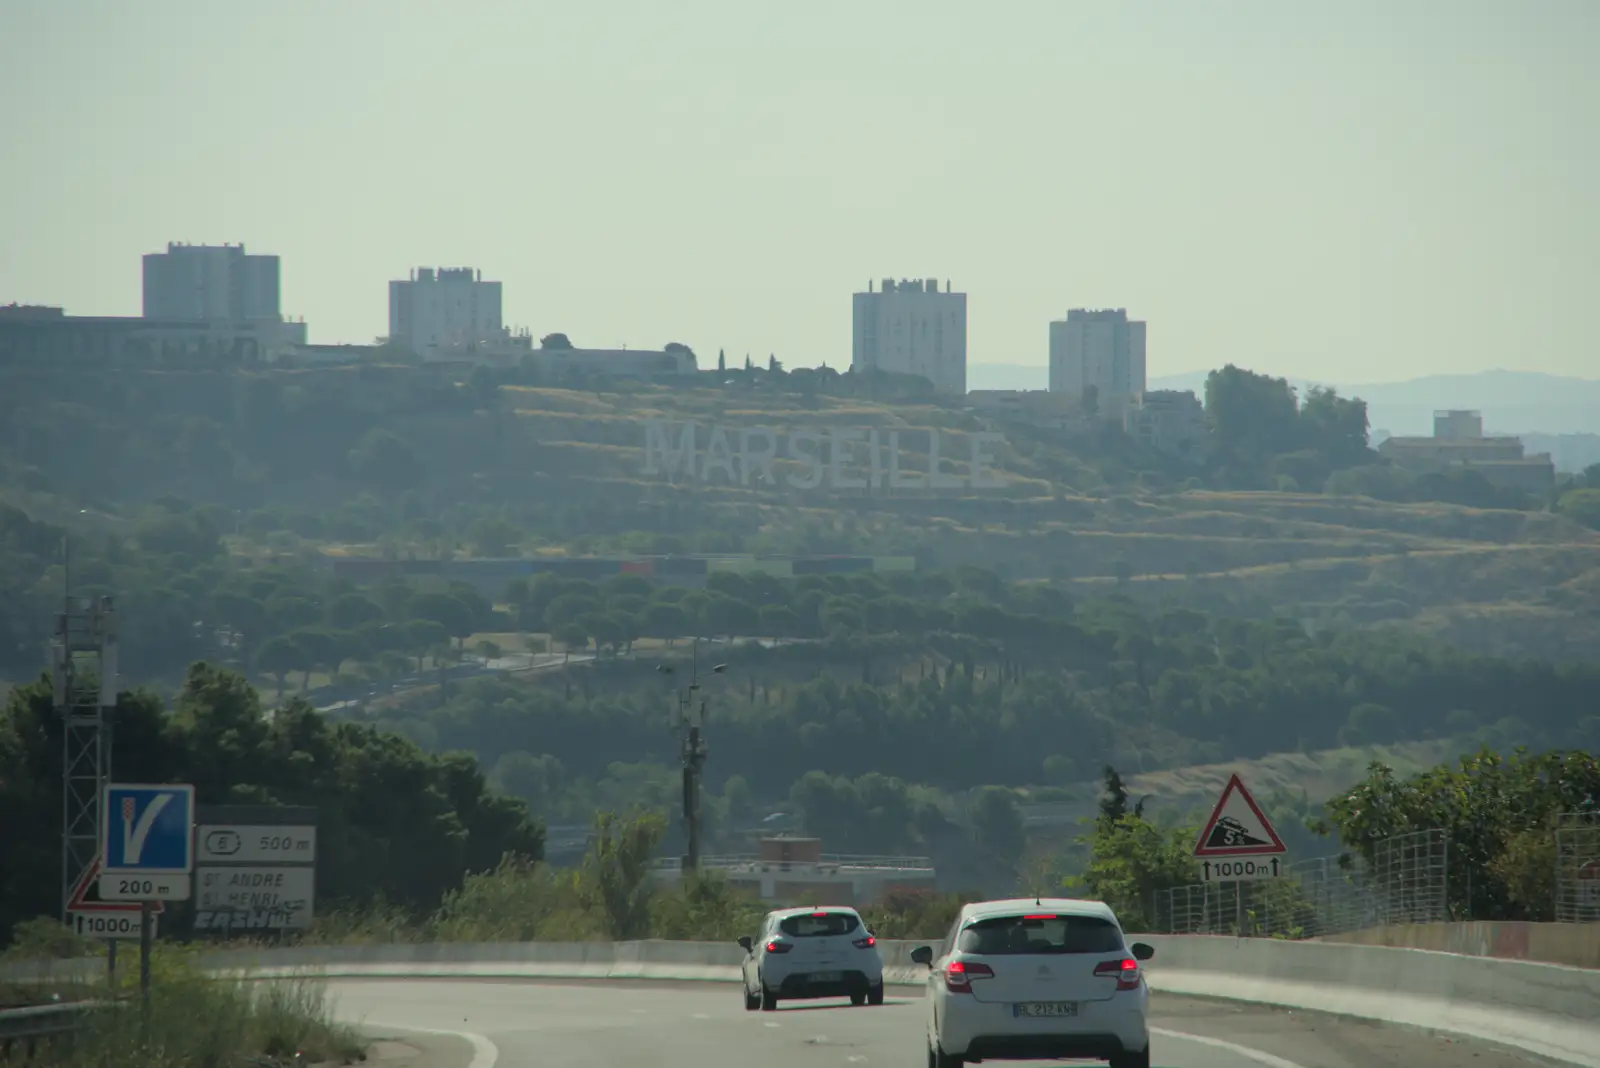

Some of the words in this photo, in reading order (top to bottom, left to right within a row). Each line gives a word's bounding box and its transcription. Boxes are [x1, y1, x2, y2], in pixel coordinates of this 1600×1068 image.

[640, 419, 1007, 489] MARSEILLE
[259, 836, 292, 850] 500
[296, 840, 310, 850] m
[119, 880, 153, 894] 200
[157, 886, 170, 894] m
[228, 873, 284, 887] ANDRE
[229, 892, 280, 906] HENRI
